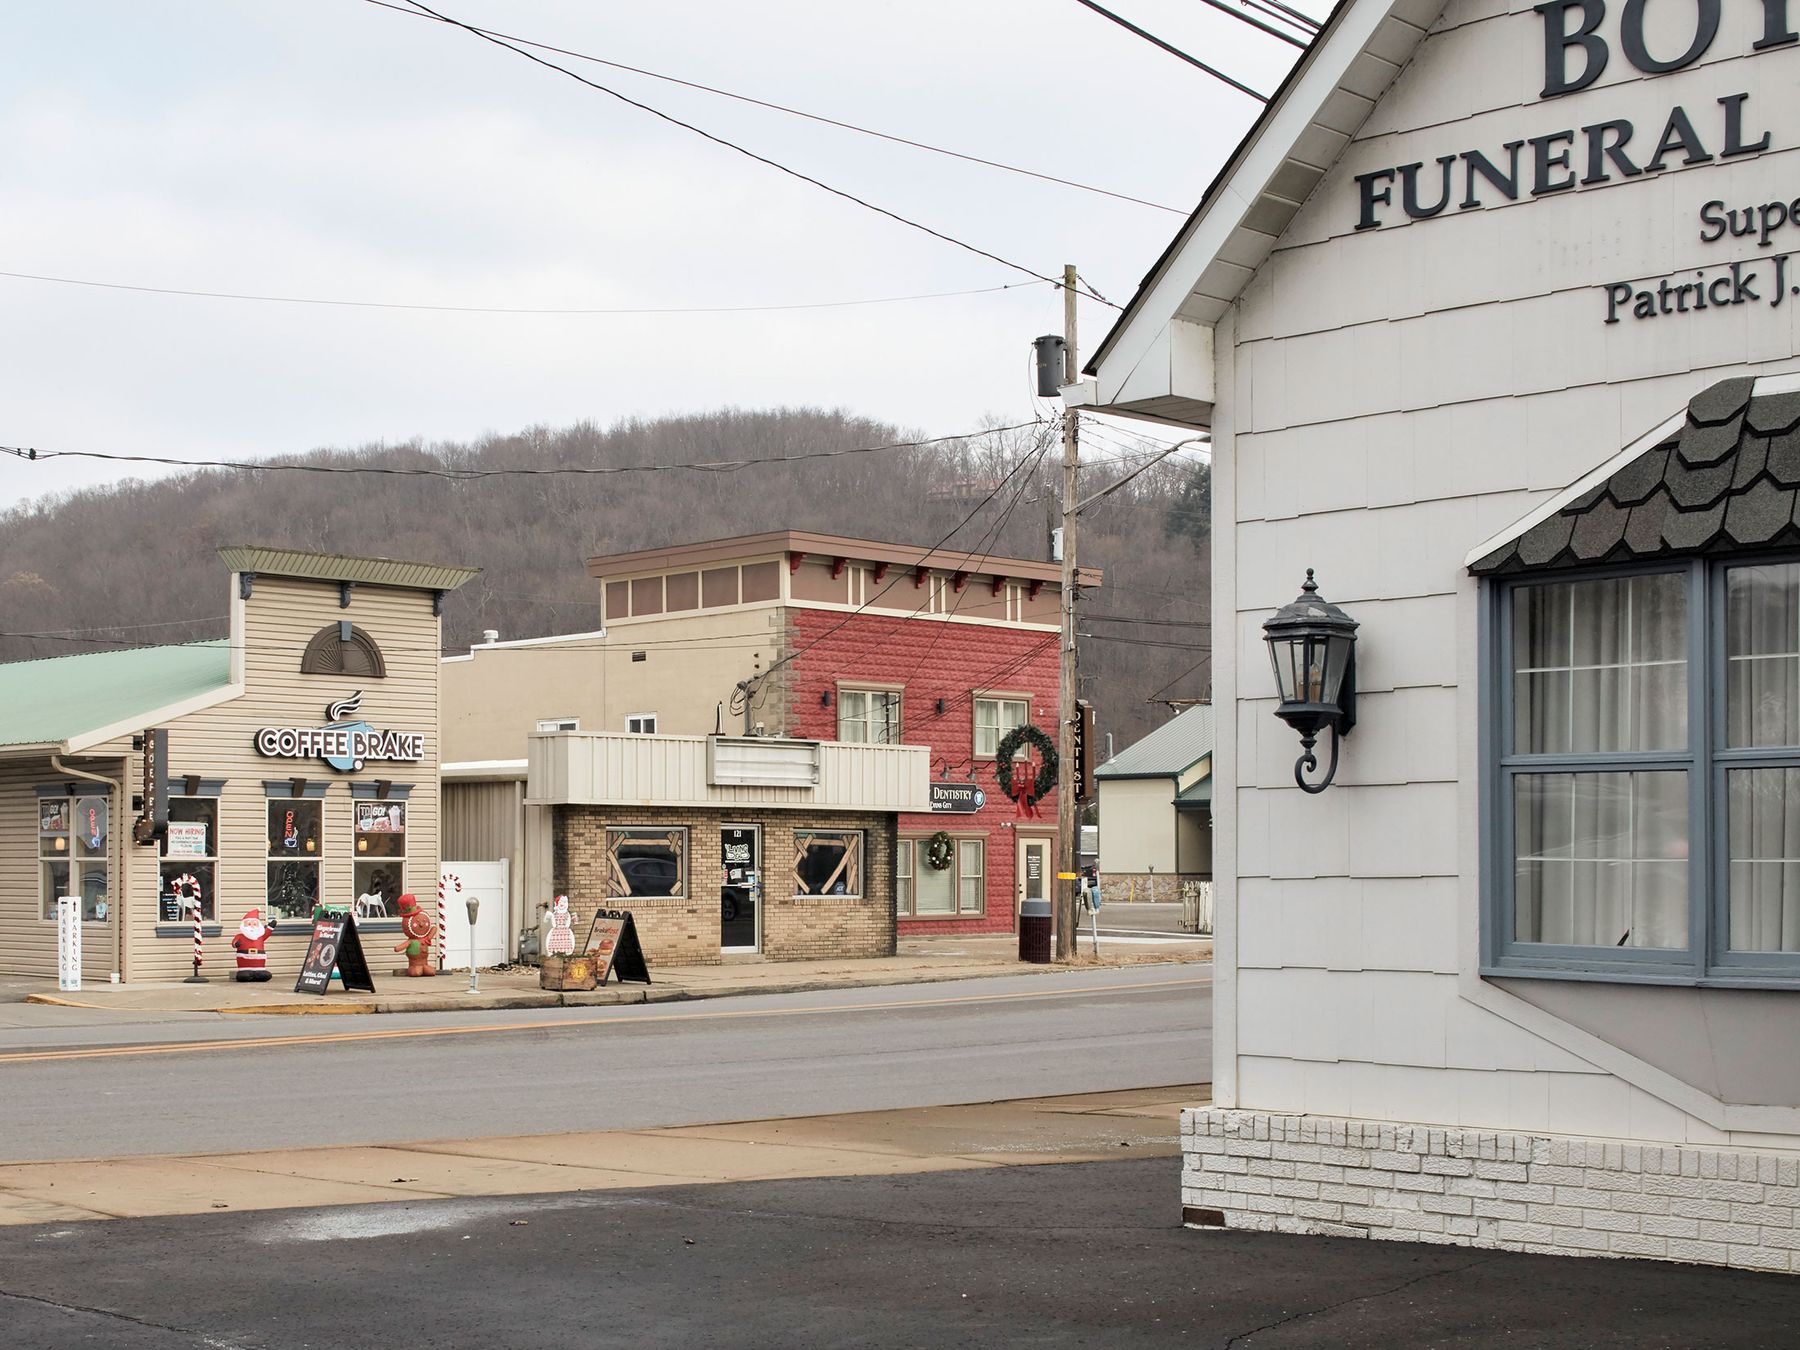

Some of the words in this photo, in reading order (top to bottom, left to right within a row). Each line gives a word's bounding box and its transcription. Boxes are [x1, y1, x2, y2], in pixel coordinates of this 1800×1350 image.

[1353, 92, 1771, 231] FUNERAL
[1604, 261, 1761, 324] Patrick
[1770, 254, 1800, 308] J.
[257, 727, 349, 759] COFFEE
[352, 730, 425, 761] BRAKE
[283, 810, 295, 838] OPEN
[372, 806, 386, 817] GO!
[169, 827, 183, 836] NOW
[185, 827, 205, 836] HIRING
